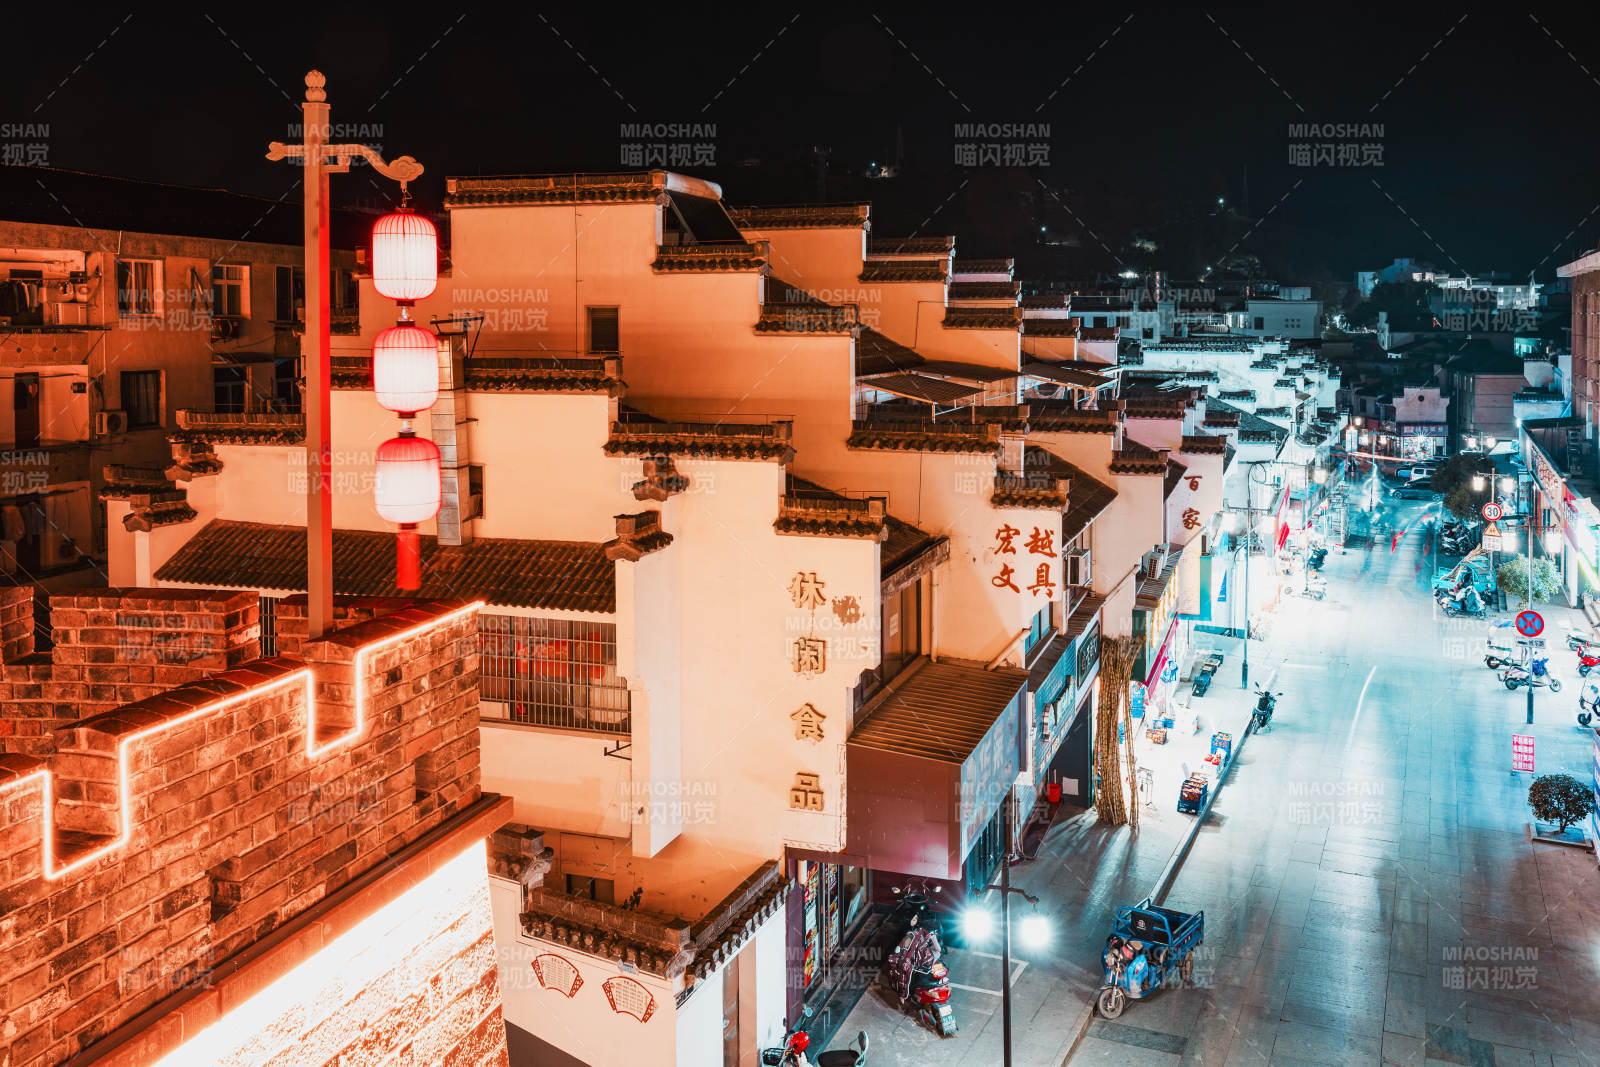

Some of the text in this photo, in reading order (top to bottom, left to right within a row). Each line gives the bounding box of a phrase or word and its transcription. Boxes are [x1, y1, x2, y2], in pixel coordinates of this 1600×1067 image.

[1182, 475, 1202, 531] 百家
[1487, 508, 1499, 517] 30
[994, 524, 1057, 559] 宏越
[992, 562, 1057, 600] 文具
[790, 571, 827, 813] 休闲食品
